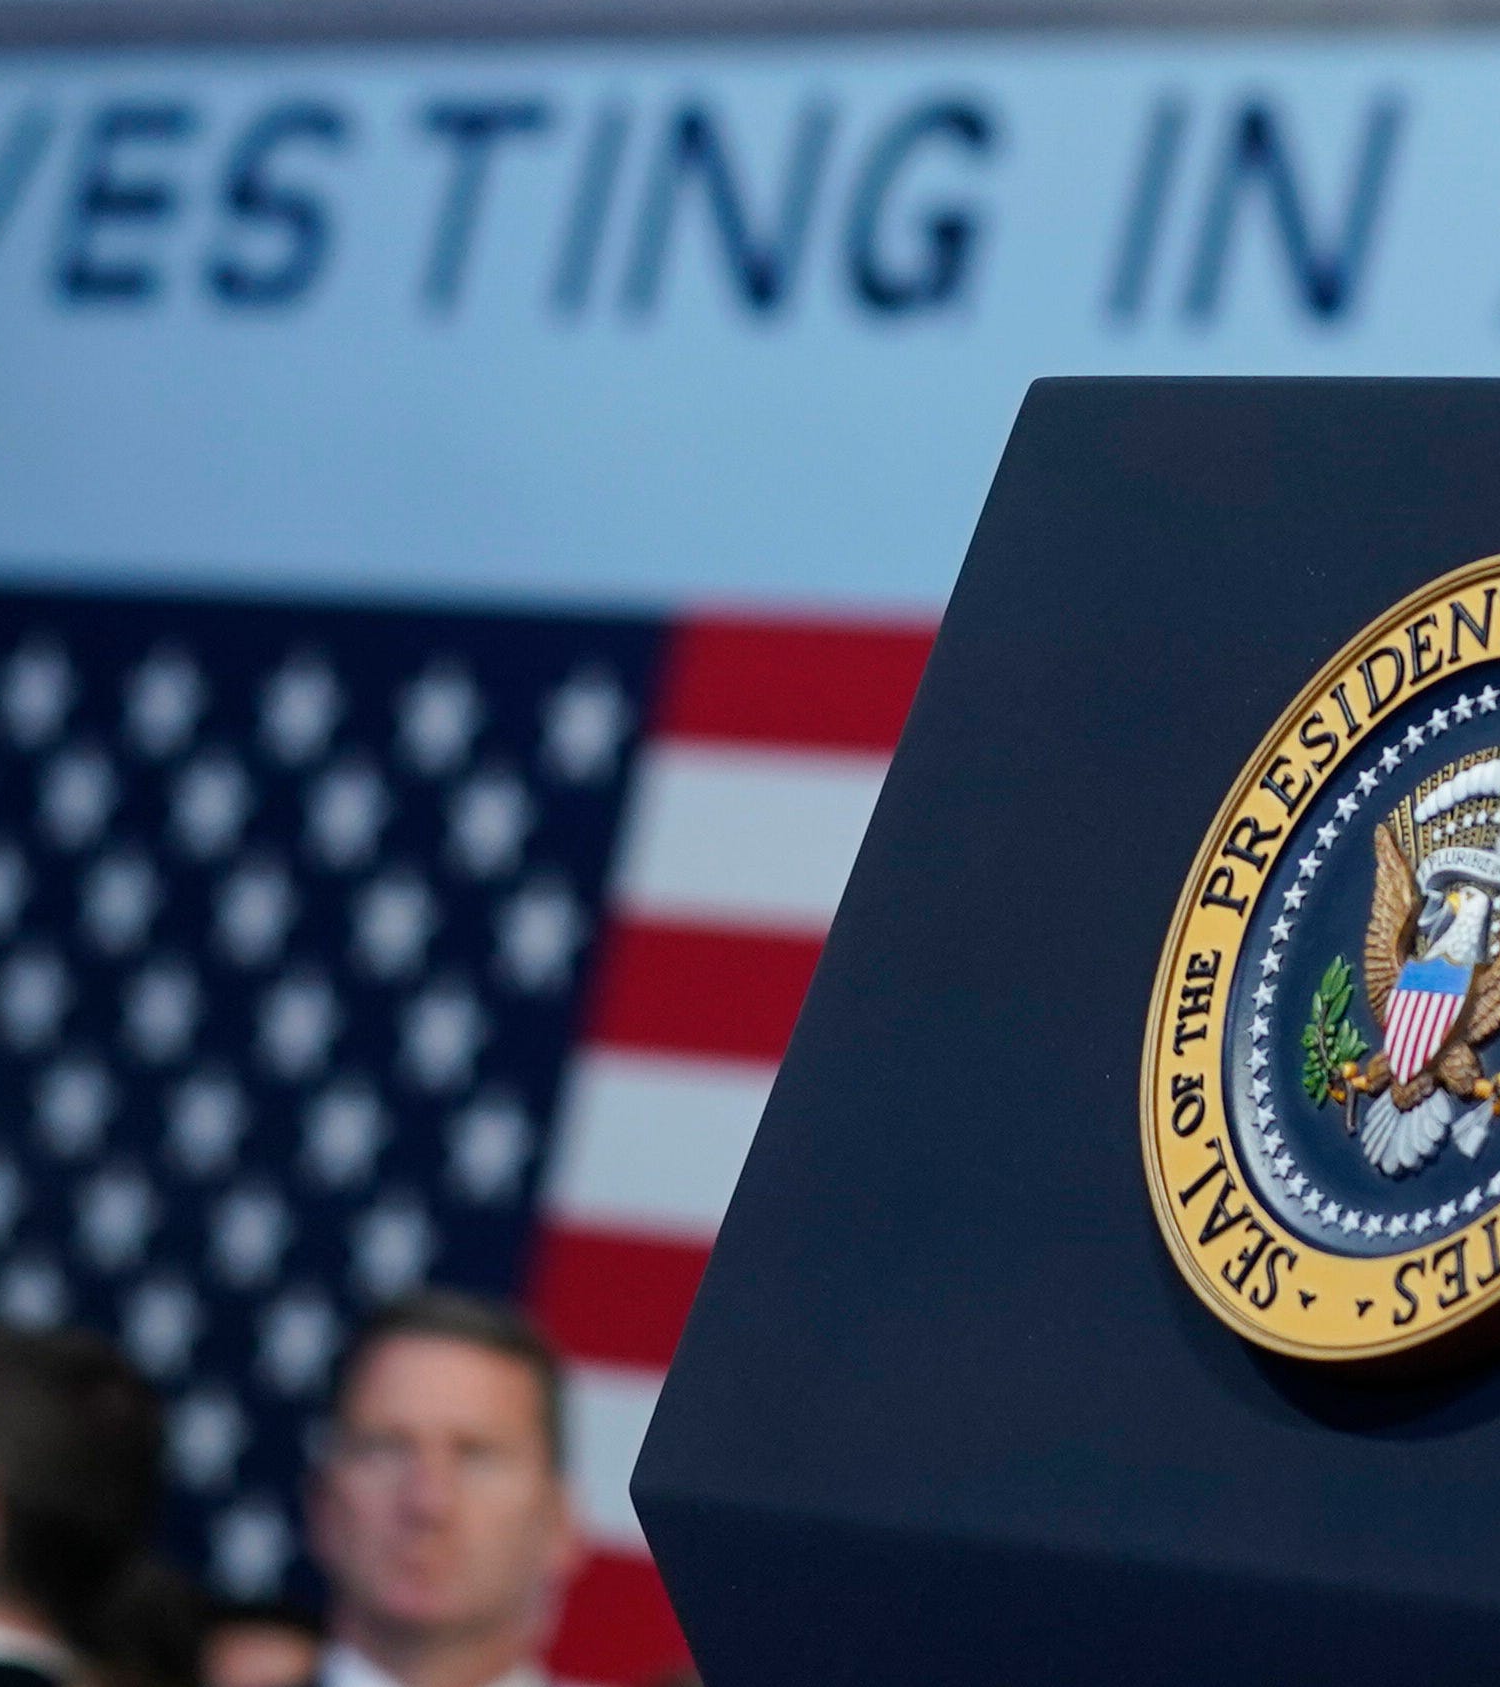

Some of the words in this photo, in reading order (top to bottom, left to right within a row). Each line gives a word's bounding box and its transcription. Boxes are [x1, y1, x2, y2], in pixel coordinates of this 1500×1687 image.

[1100, 78, 1412, 332] IN
[1172, 948, 1223, 1057] THE
[1170, 1072, 1206, 1138] OF
[1177, 1136, 1299, 1312] SEAL
